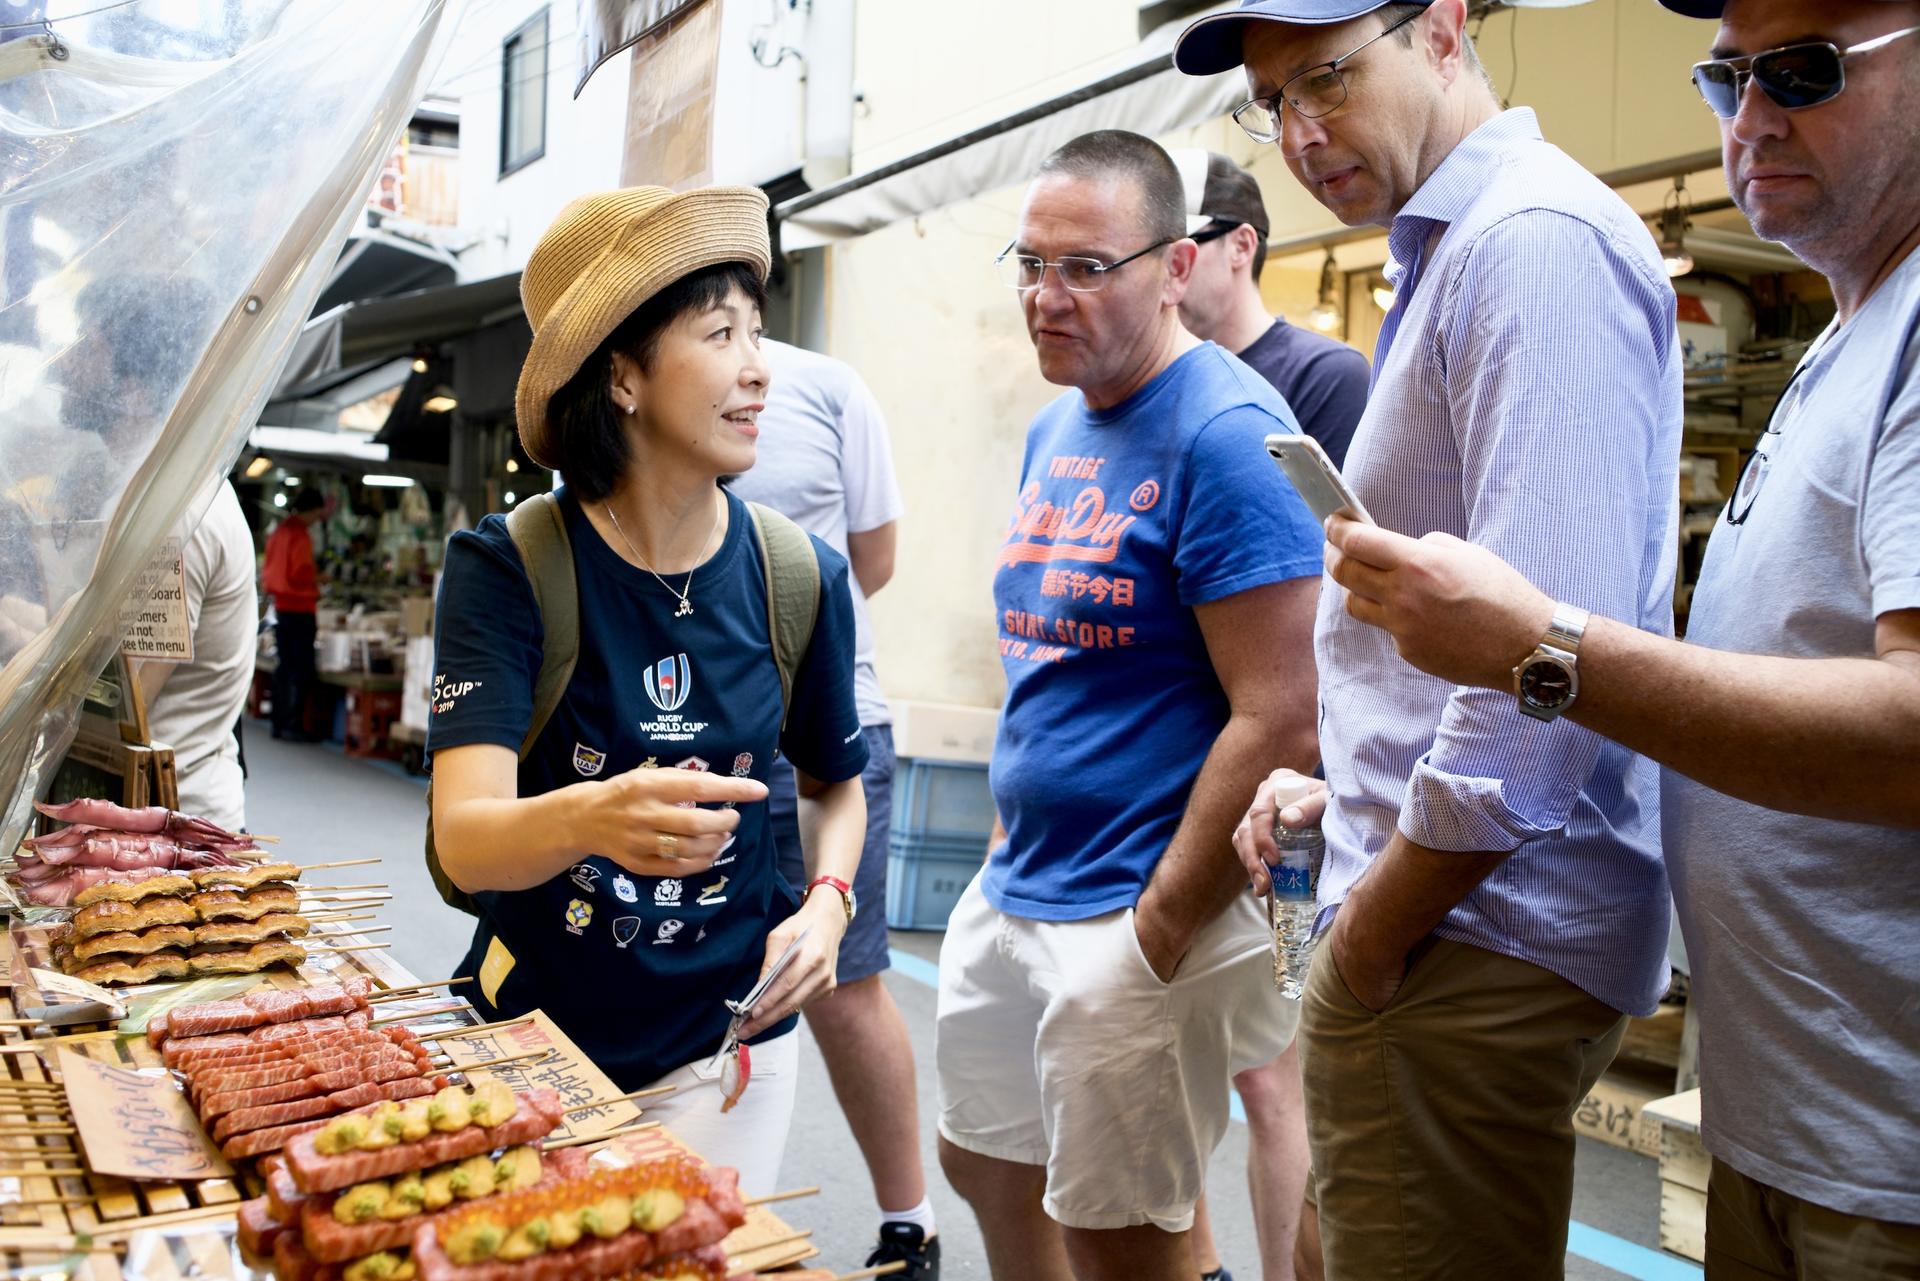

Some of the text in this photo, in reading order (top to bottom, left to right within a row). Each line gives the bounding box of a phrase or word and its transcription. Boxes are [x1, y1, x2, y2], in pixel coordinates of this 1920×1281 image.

[1048, 456, 1105, 480] VINTAGE
[136, 623, 153, 637] not
[122, 636, 185, 652] see the menu
[438, 700, 455, 713] 2019
[657, 714, 683, 722] RUGBY
[640, 721, 681, 732] WORLD
[576, 759, 598, 772] UAR
